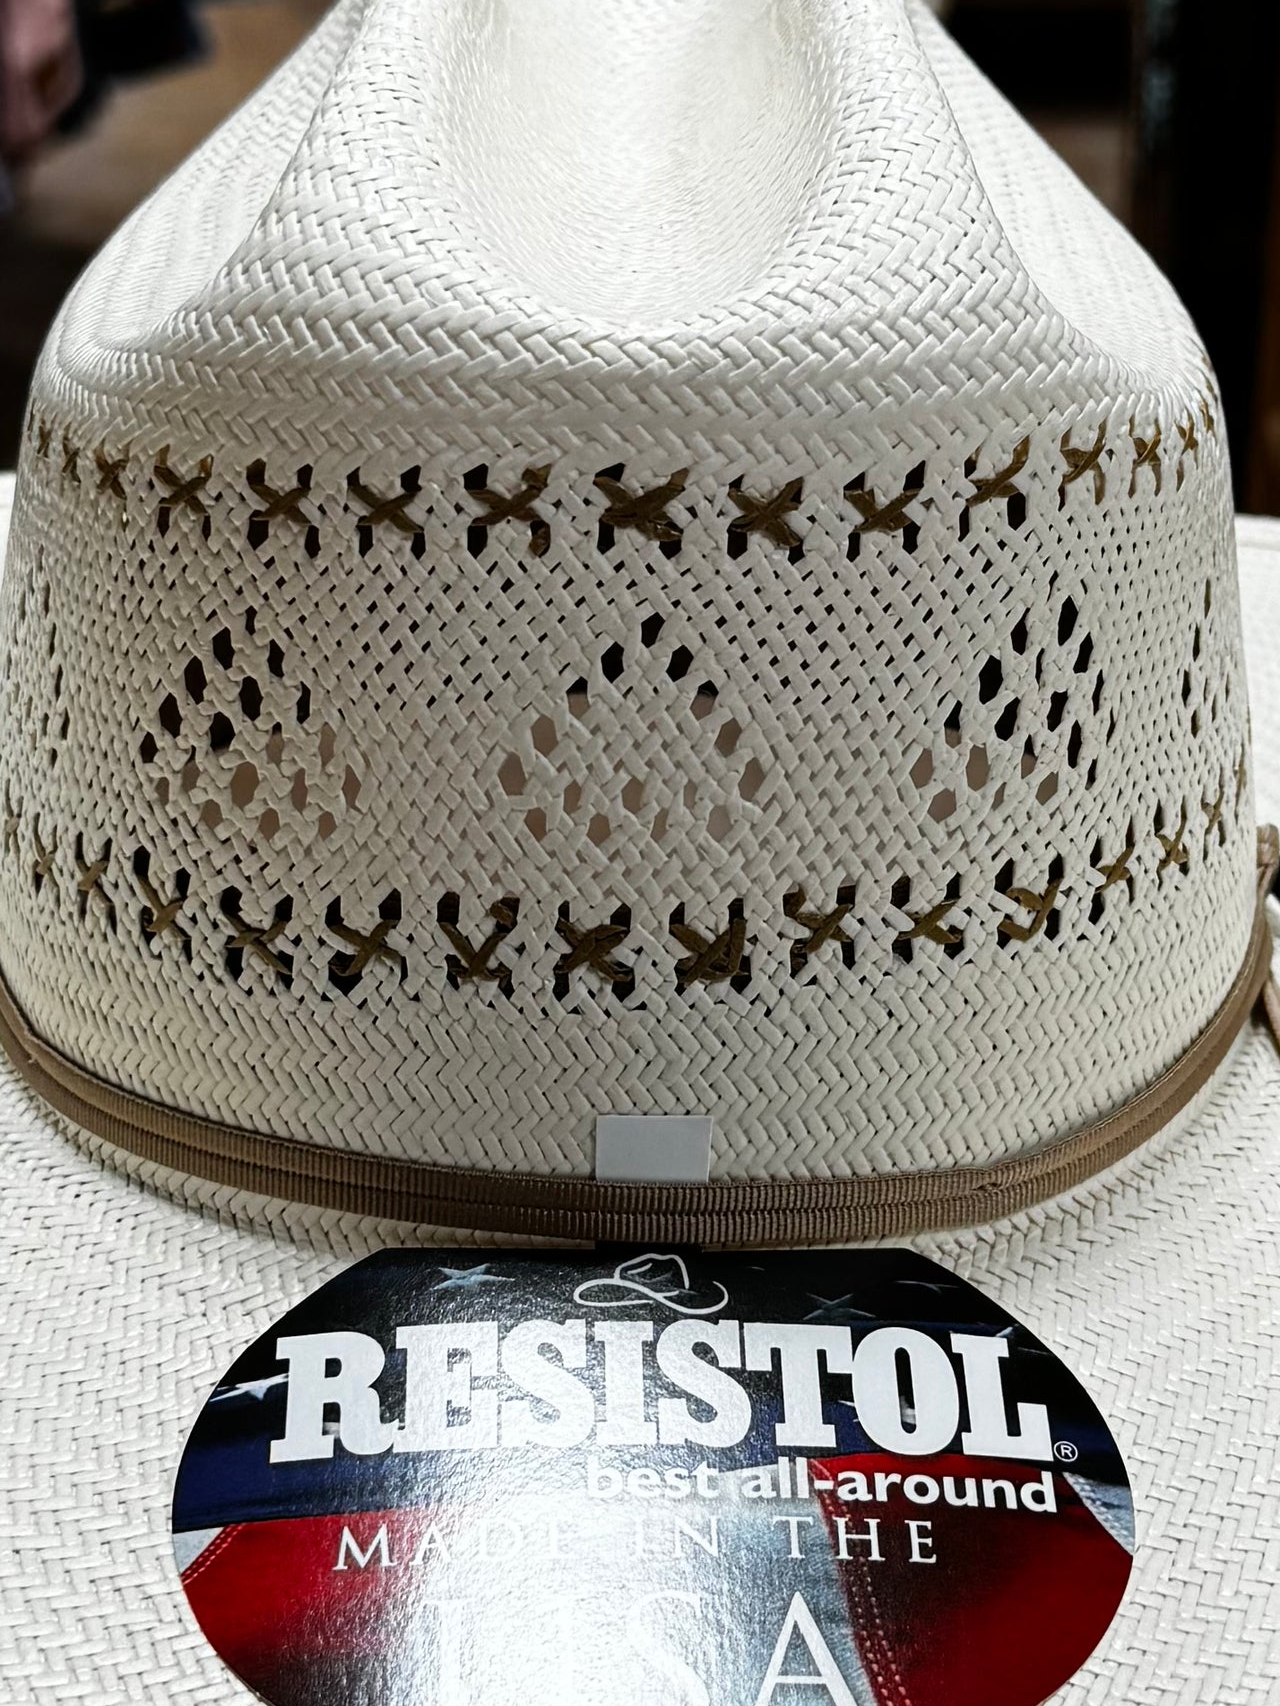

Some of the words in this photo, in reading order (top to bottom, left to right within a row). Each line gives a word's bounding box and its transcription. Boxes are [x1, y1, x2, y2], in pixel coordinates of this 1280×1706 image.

[585, 1456, 722, 1499] best
[741, 1455, 1058, 1514] all-around
[331, 1515, 576, 1573] MADE
[635, 1515, 723, 1561] IN
[772, 1515, 938, 1565] THE
